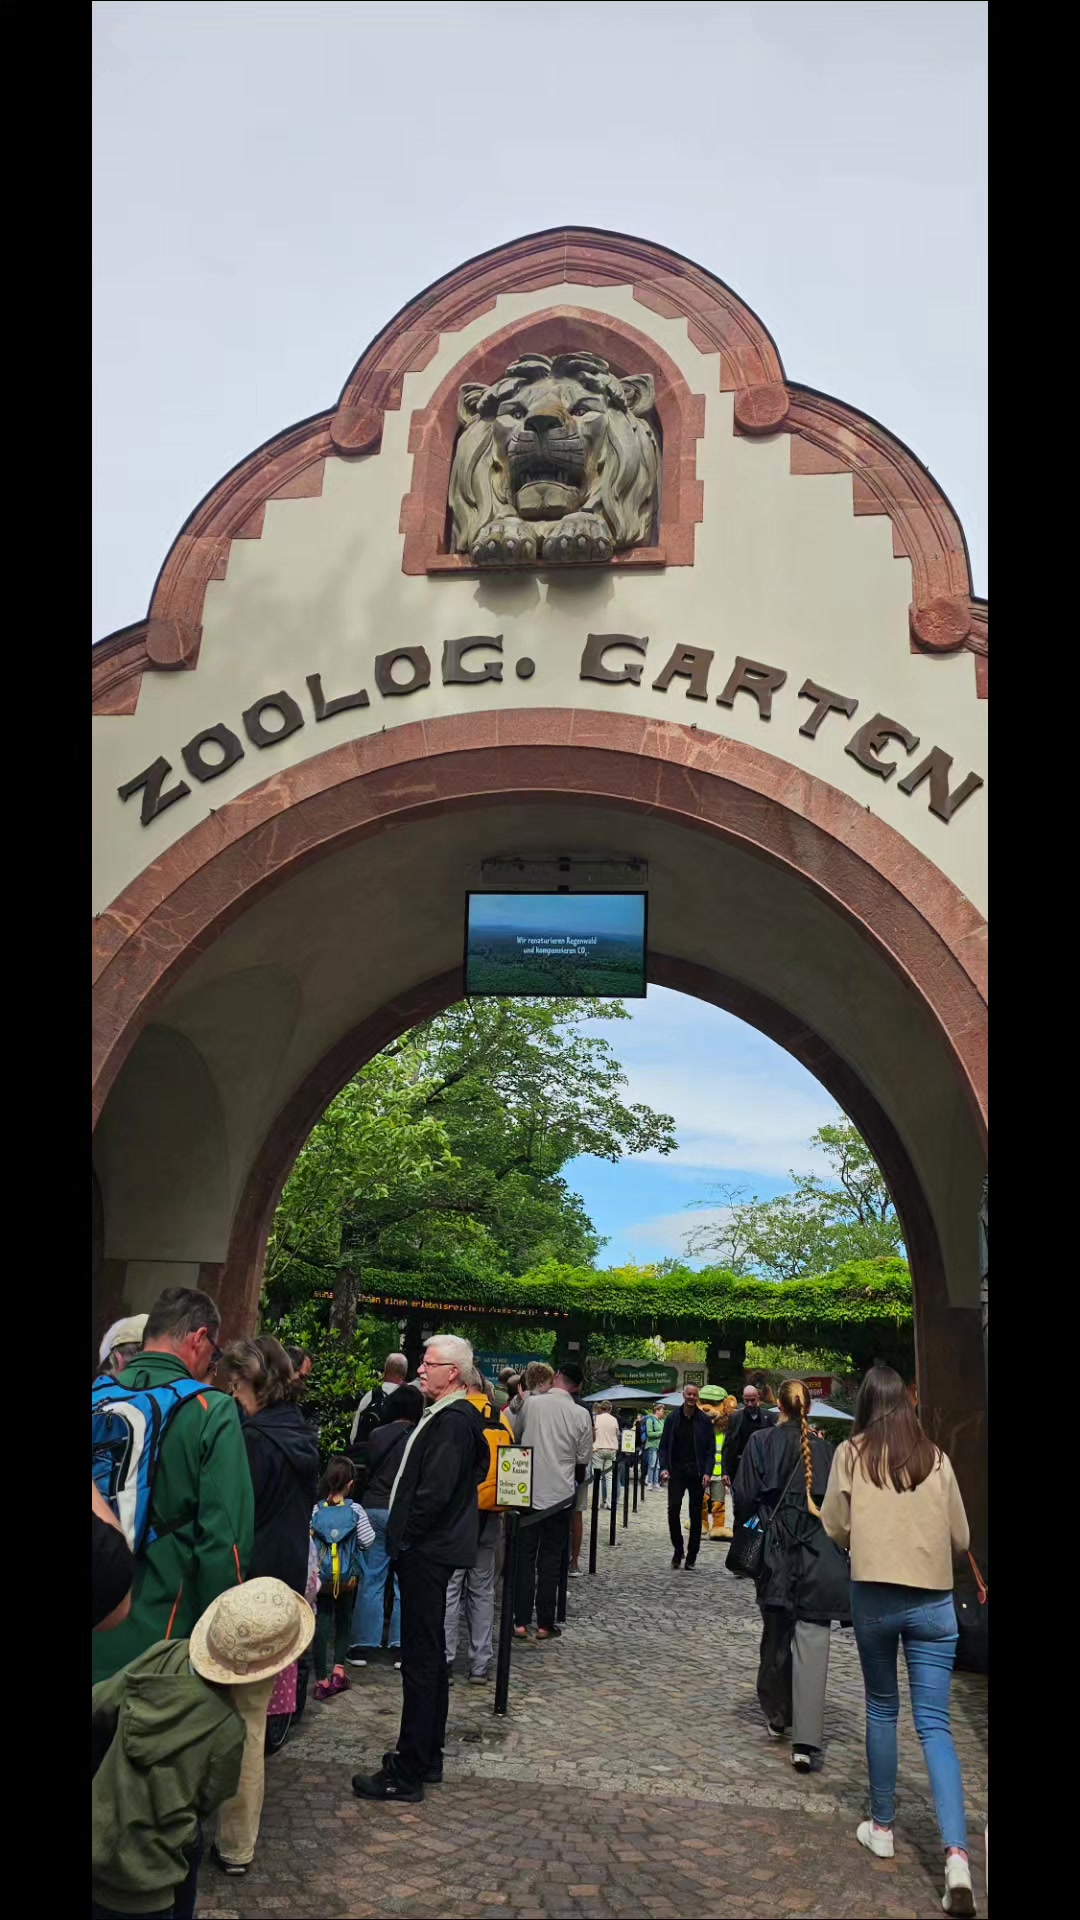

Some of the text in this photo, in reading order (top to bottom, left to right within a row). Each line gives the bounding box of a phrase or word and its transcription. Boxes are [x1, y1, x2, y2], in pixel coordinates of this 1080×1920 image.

[117, 633, 984, 826] ZOOLOG. GARTEN
[517, 936, 597, 946] Wir renaturieren Regenwald
[523, 946, 534, 954] und
[536, 946, 576, 956] kompensieren
